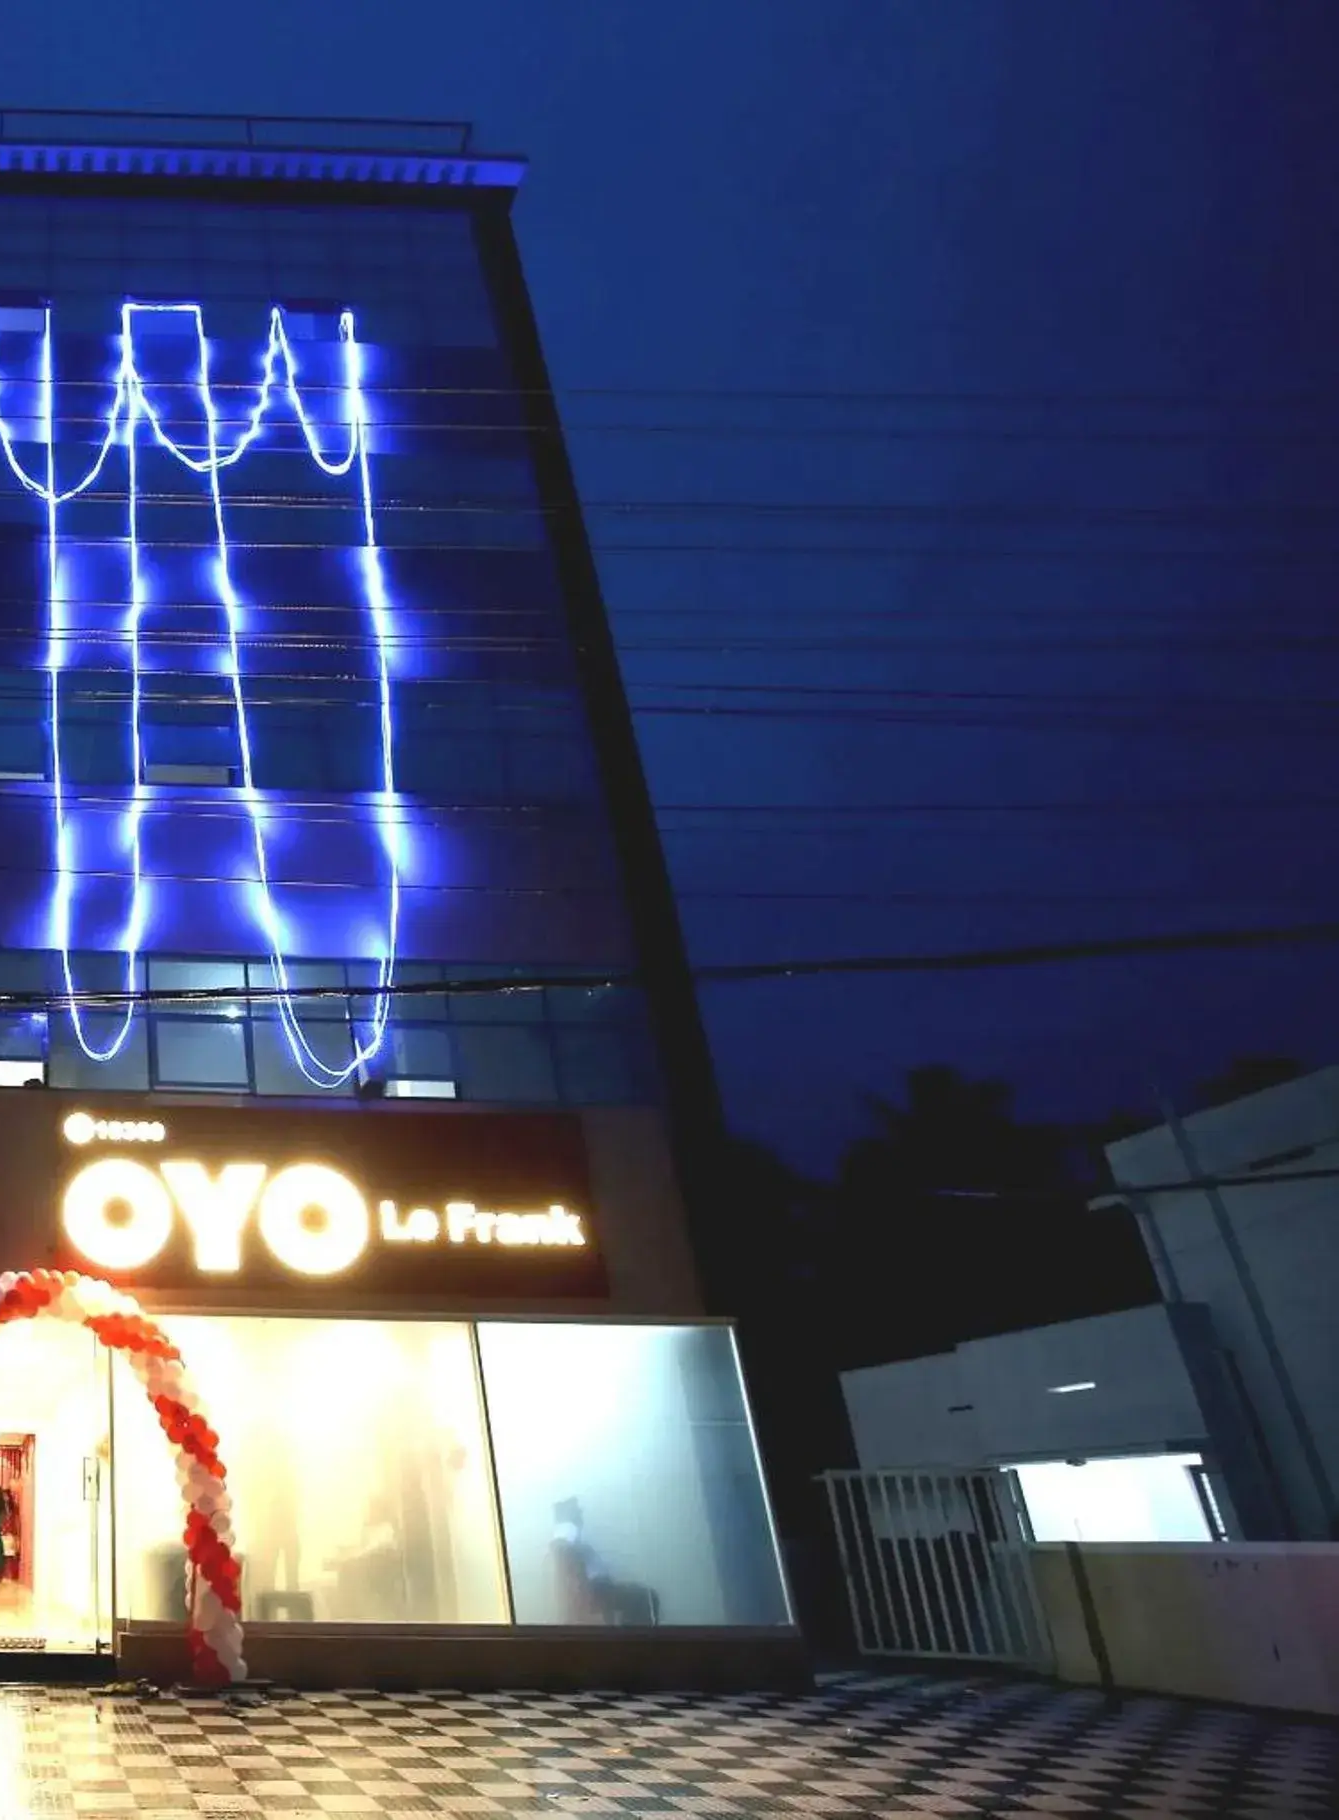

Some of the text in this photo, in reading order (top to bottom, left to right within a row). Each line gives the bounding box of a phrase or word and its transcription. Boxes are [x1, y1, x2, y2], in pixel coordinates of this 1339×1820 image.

[62, 1158, 586, 1276] OYO Le Frank
